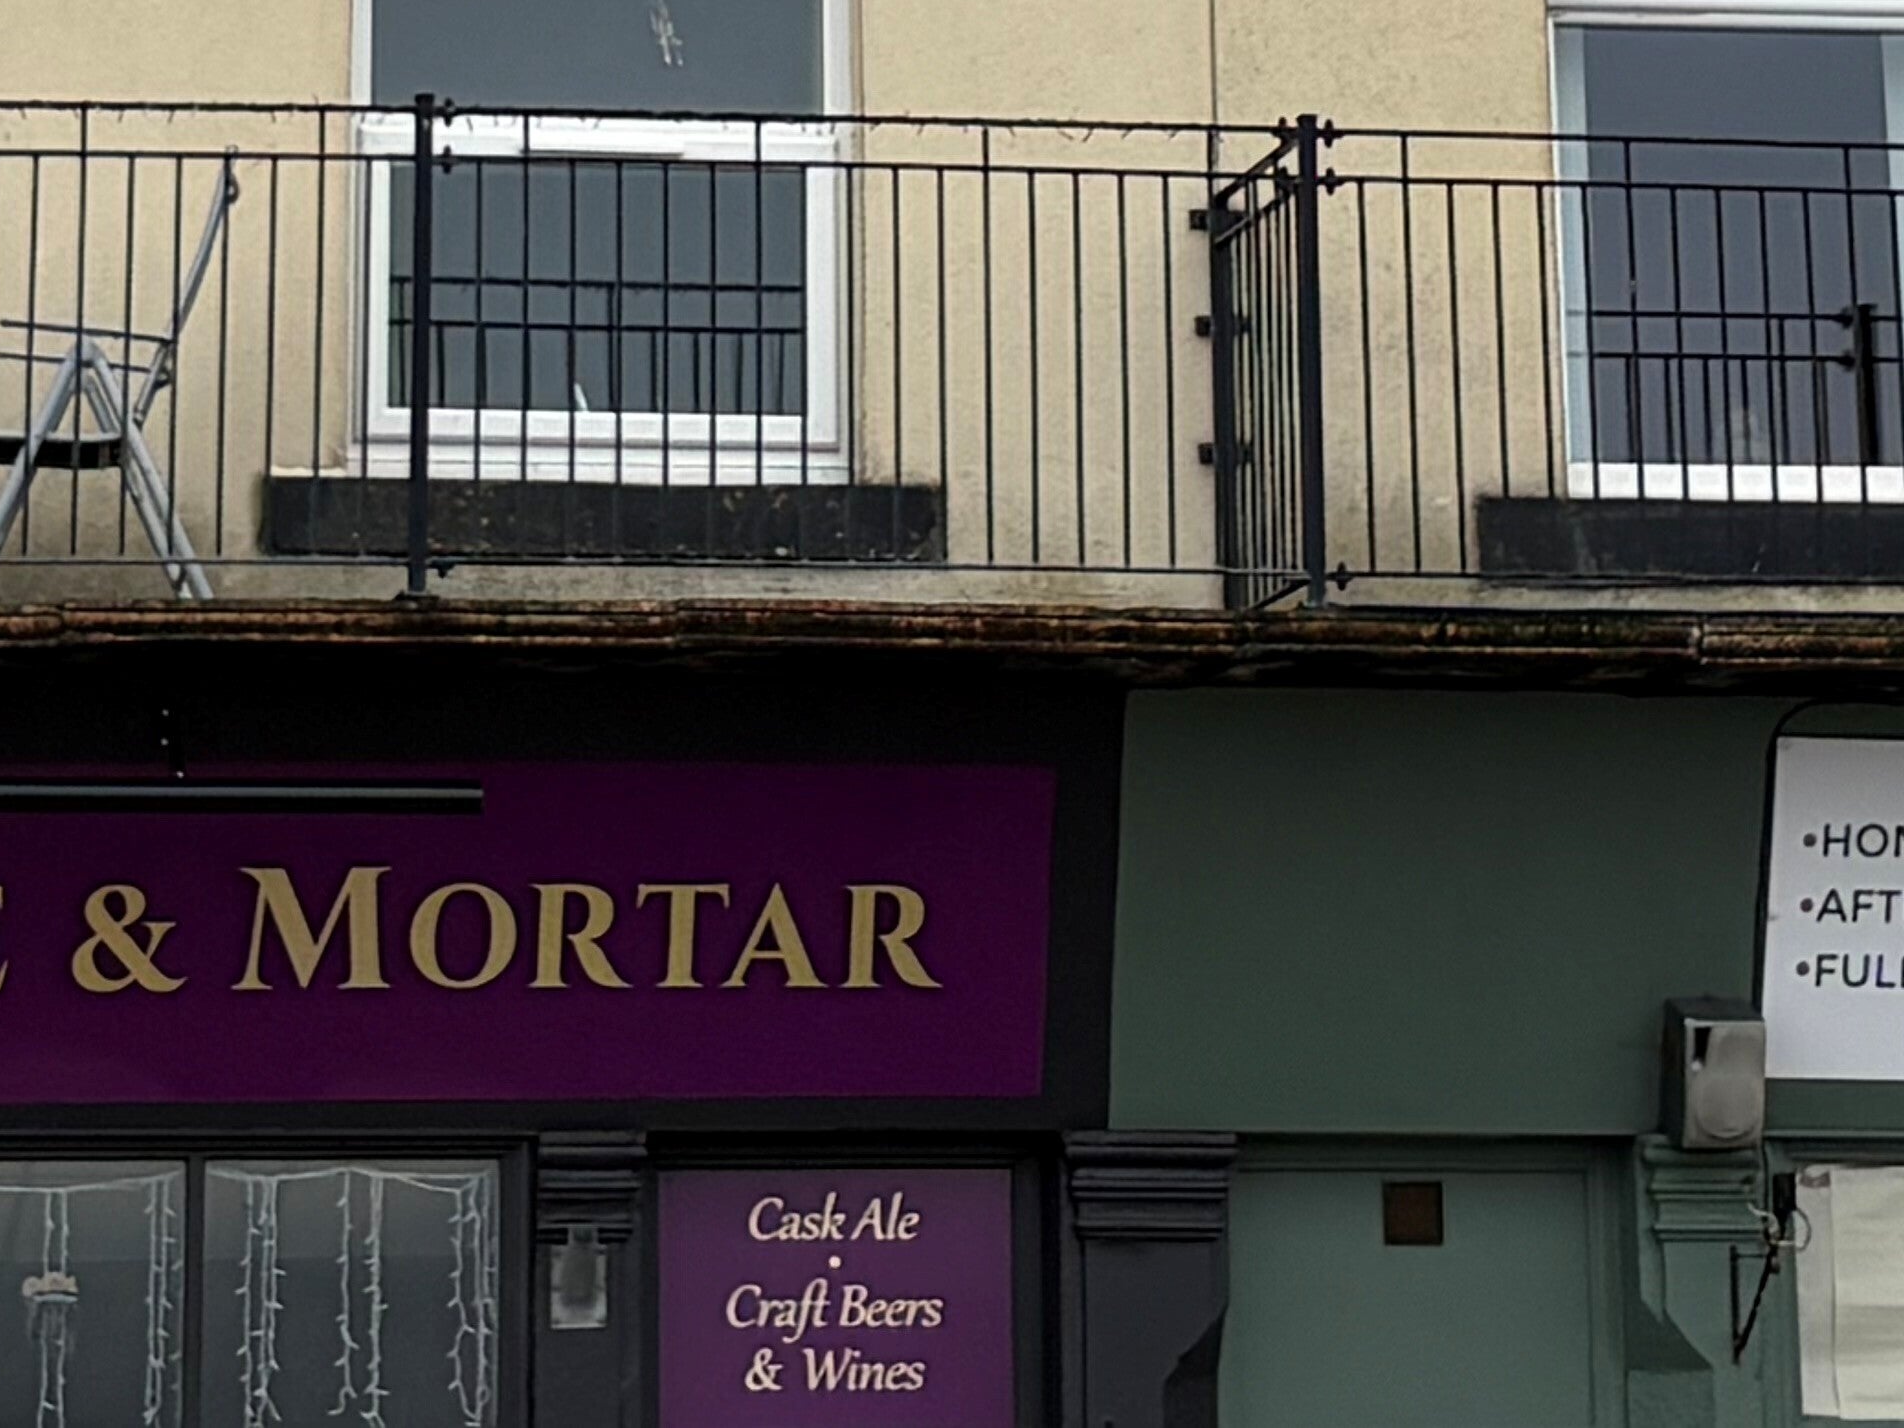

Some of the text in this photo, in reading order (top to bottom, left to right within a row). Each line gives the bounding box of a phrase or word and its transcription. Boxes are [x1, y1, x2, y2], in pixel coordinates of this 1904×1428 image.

[70, 883, 187, 993] &
[230, 866, 944, 991] MORTAR
[748, 1191, 921, 1241] Cask Ale
[725, 1277, 944, 1343] Craft Beers
[744, 1347, 926, 1391] & Wines
